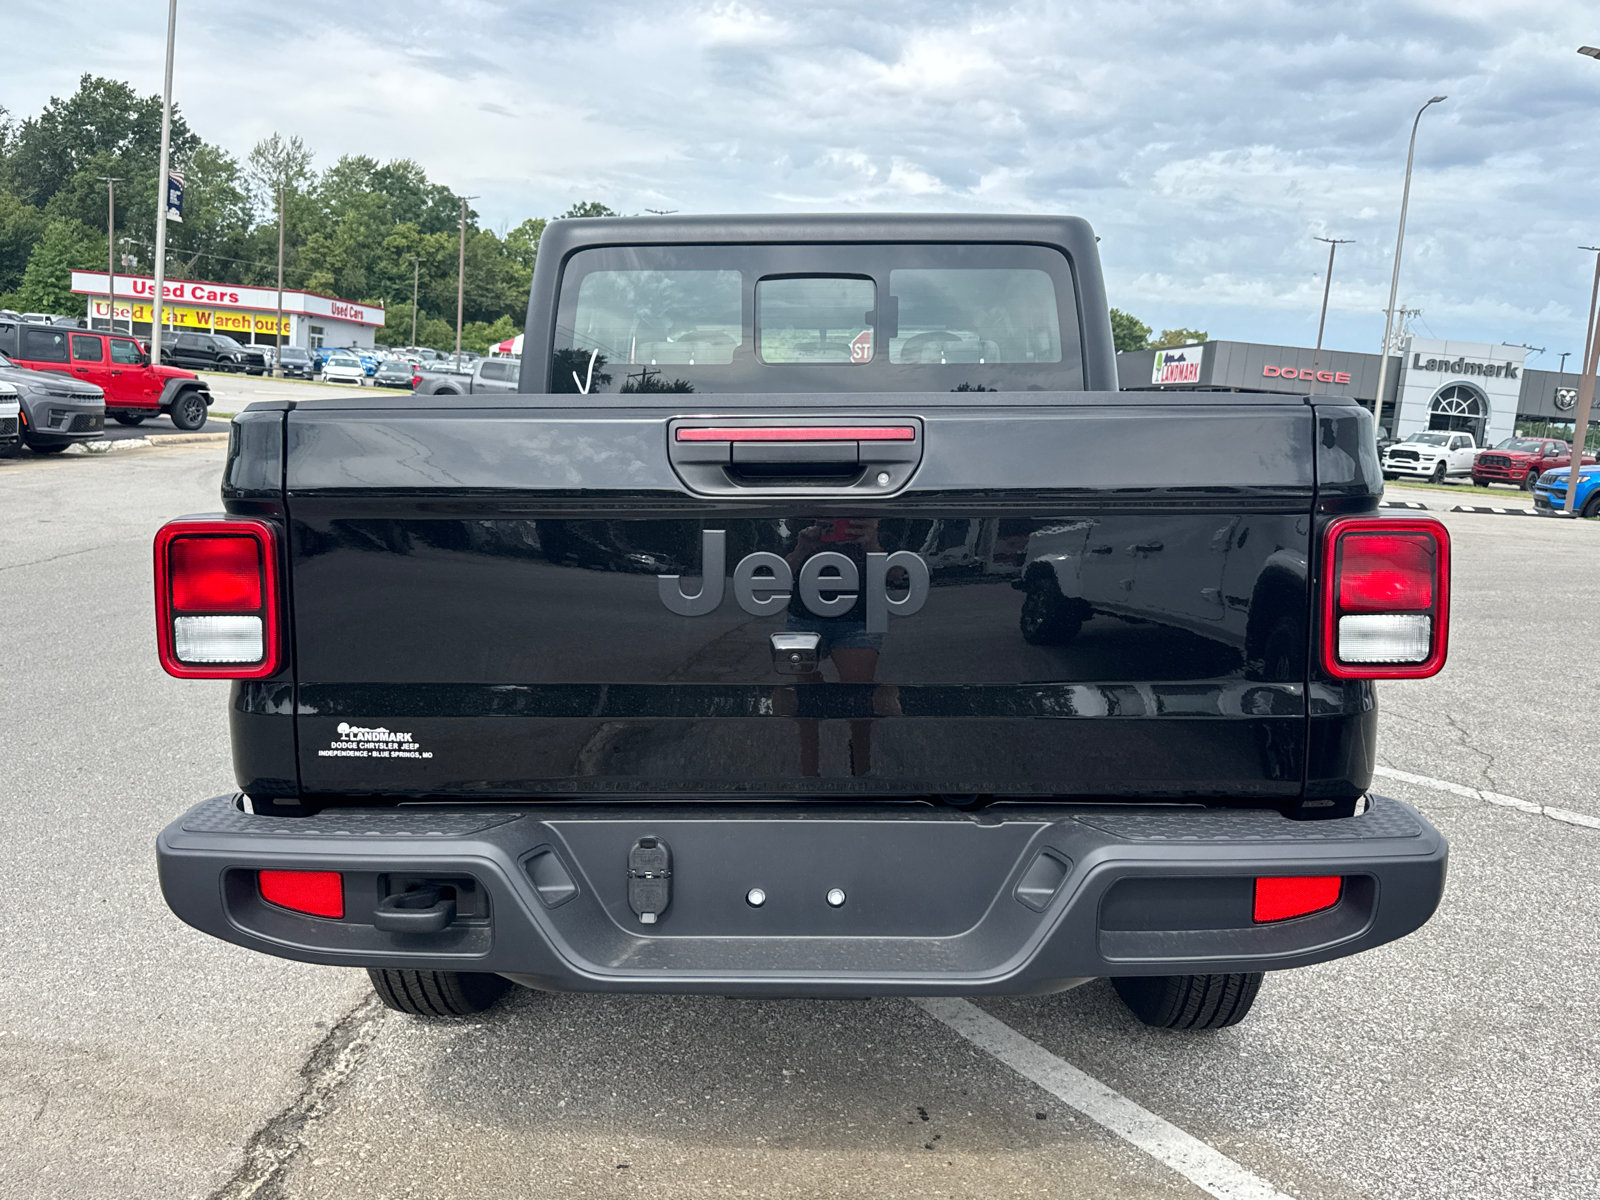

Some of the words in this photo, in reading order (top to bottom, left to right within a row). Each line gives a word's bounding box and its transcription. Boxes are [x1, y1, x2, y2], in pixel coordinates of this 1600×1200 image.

[132, 280, 185, 298] Used
[191, 286, 239, 303] Cars
[95, 302, 144, 319] Used
[331, 302, 348, 317] Used
[349, 306, 363, 320] Cars
[853, 343, 870, 359] ST
[1161, 362, 1200, 382] LANDMARK
[1263, 365, 1351, 384] DODGE
[1412, 353, 1518, 379] Landmark
[657, 529, 930, 633] Jeep
[331, 741, 358, 749] DODGE
[359, 742, 399, 750] CHRYSLER
[349, 732, 413, 742] LANDMARK
